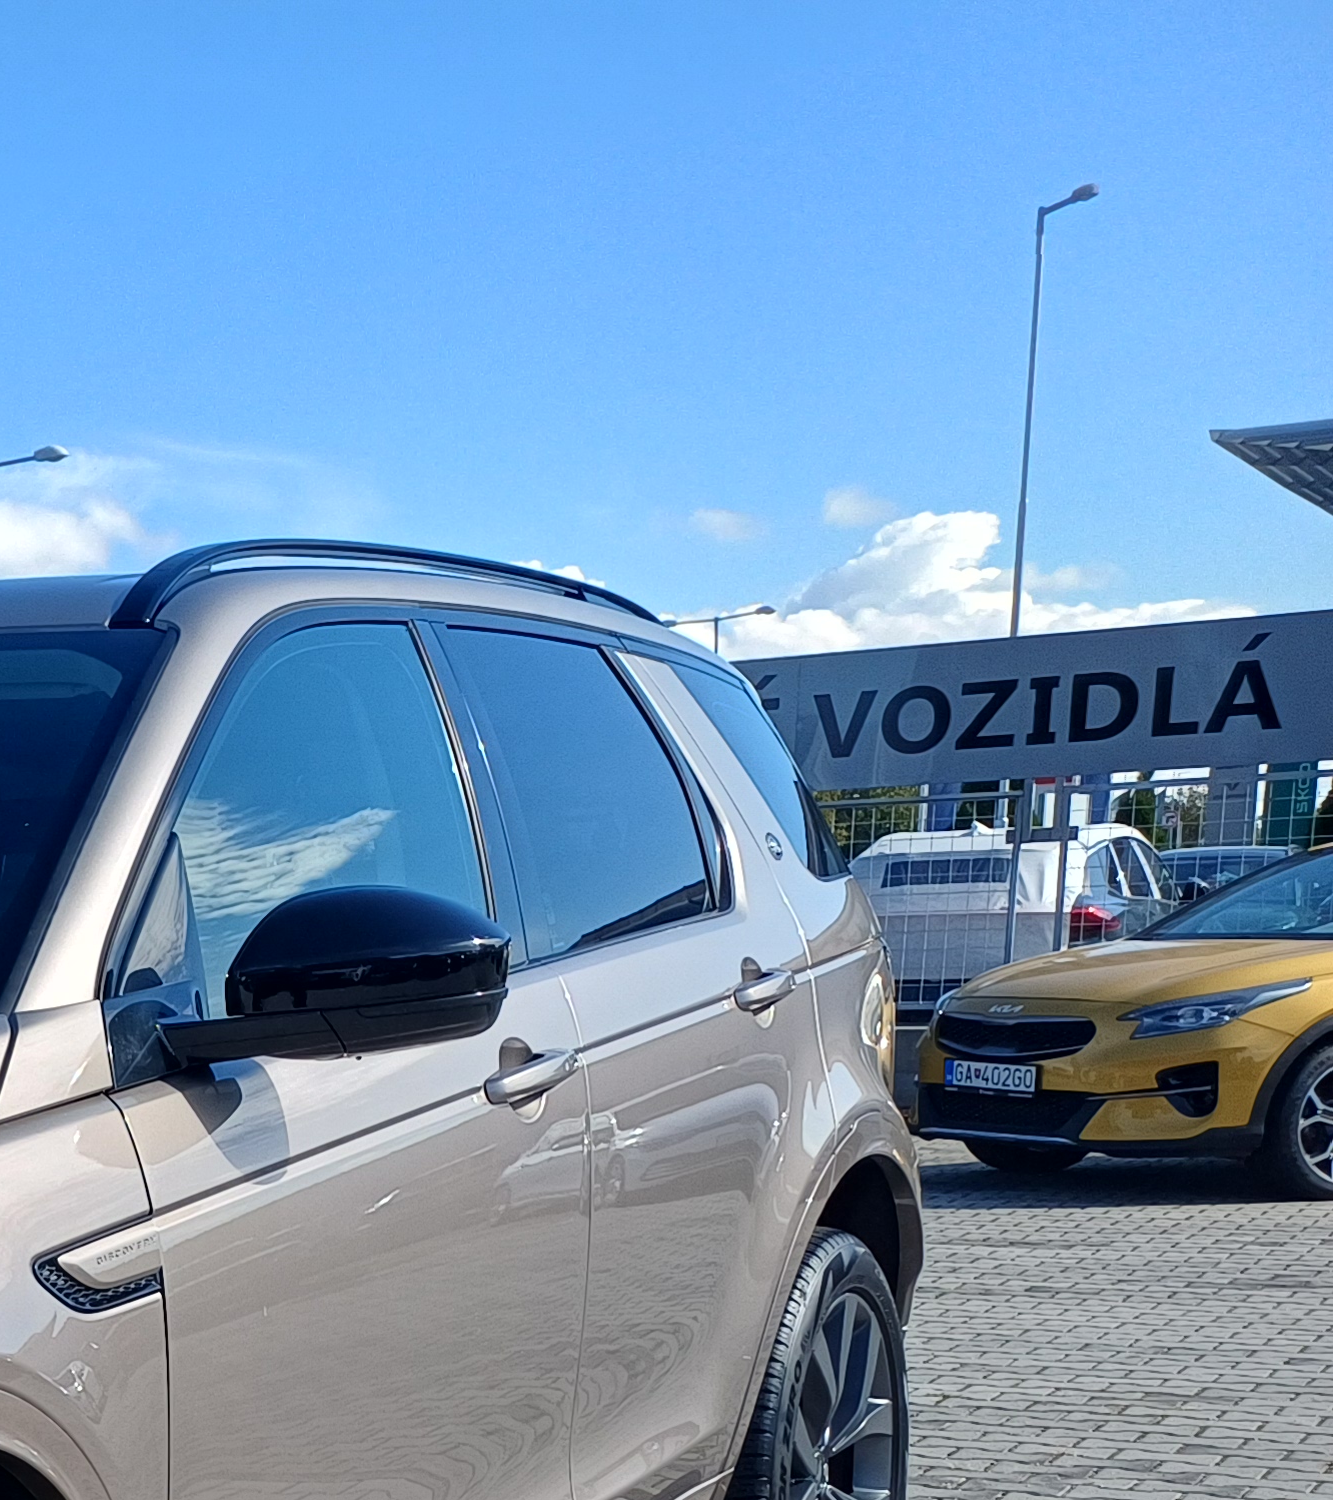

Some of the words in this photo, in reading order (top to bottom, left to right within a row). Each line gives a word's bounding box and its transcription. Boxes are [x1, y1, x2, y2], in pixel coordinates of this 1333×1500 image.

[814, 632, 1282, 758] VOZIDLÁ
[954, 1062, 973, 1084] GA
[96, 1234, 157, 1265] DISCOVERY
